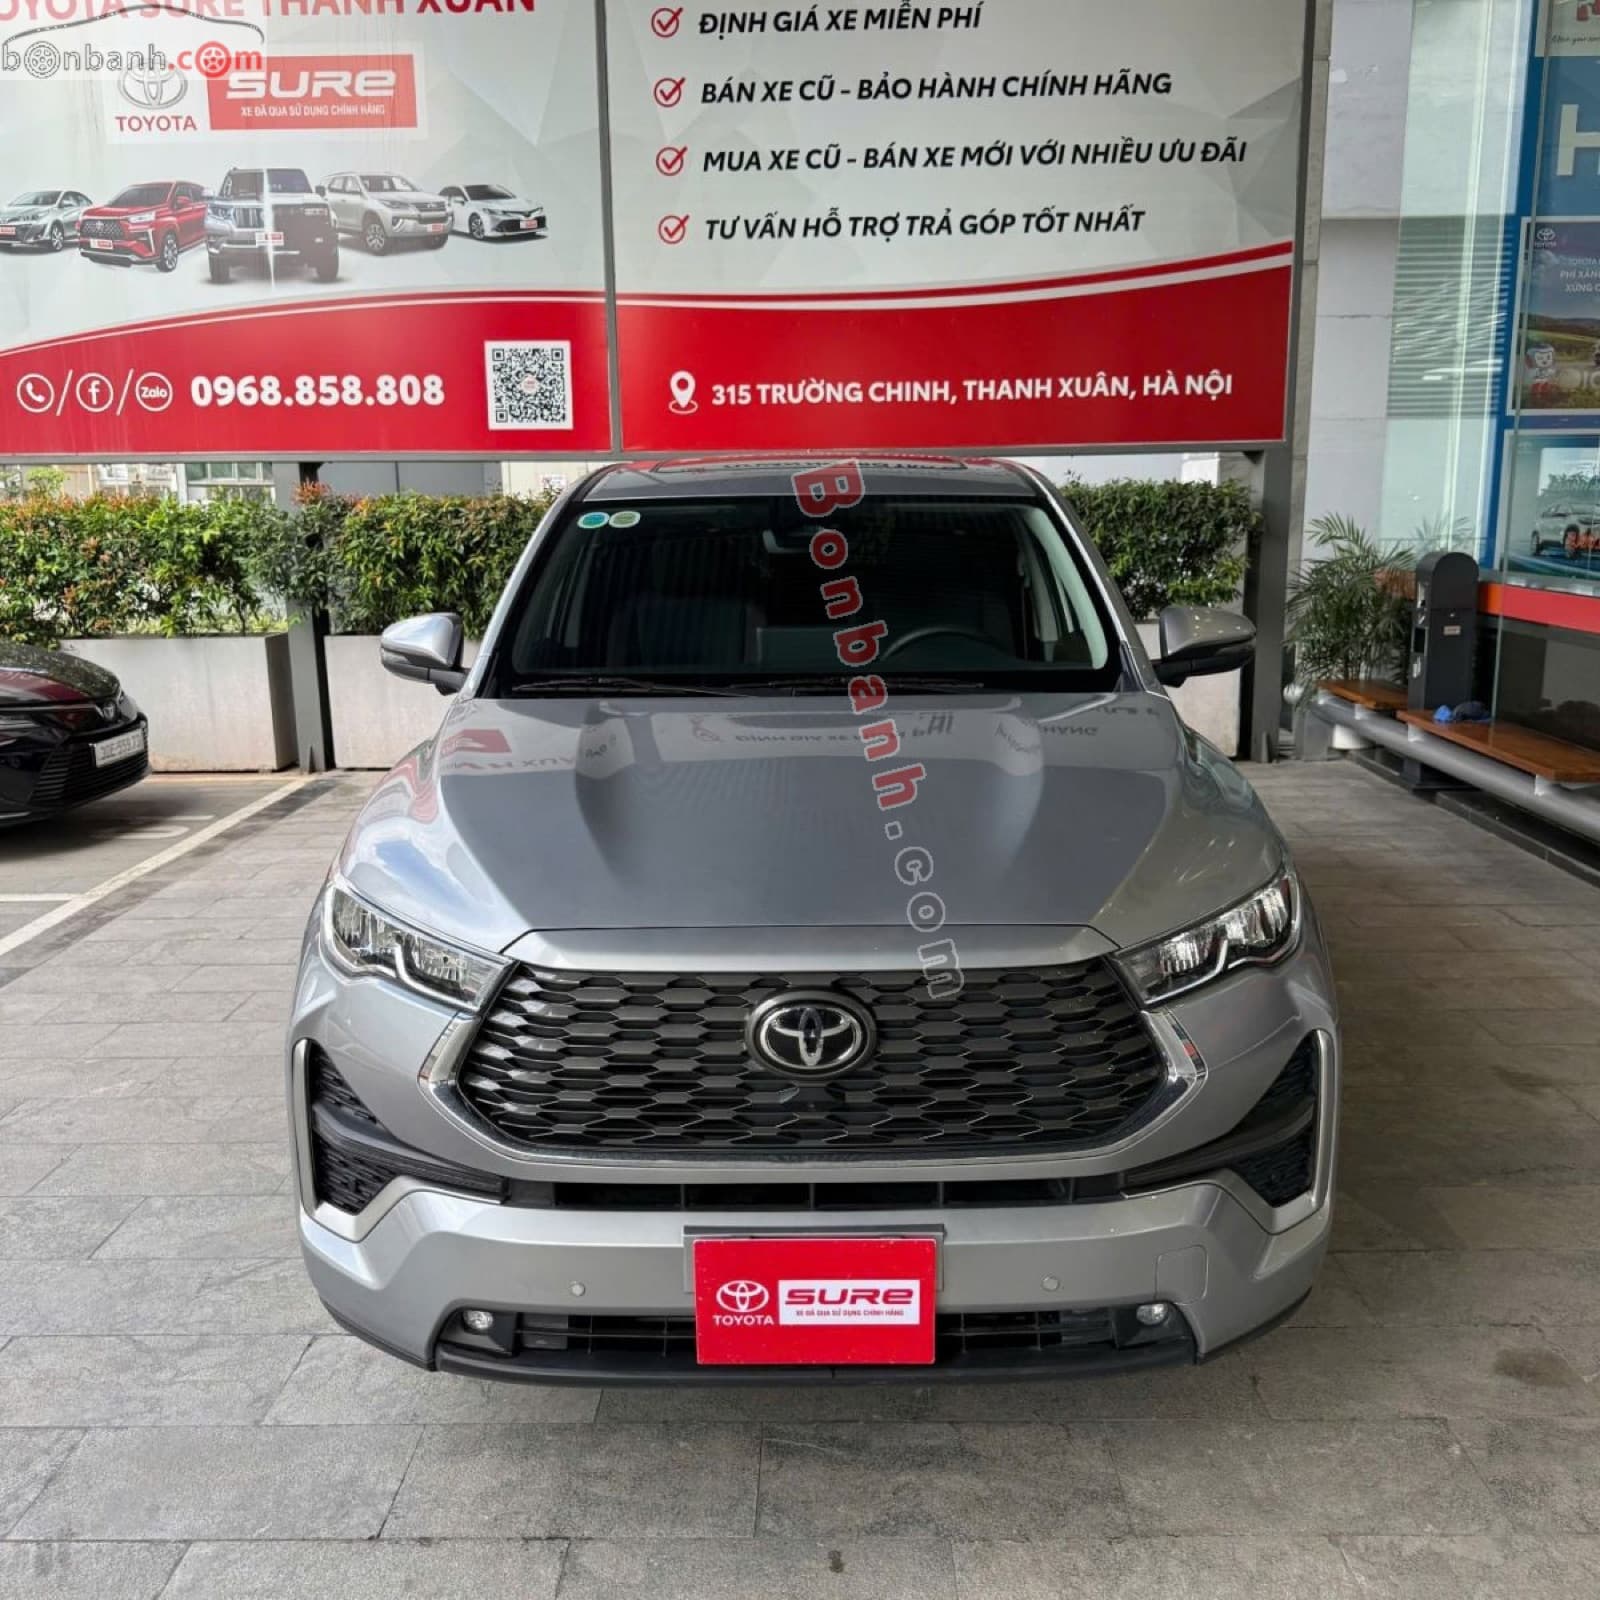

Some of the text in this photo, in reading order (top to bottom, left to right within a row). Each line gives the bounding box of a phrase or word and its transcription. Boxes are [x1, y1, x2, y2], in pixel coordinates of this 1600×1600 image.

[699, 0, 984, 40] ĐỊNH GIÁ XE MIỄN PHÍ
[702, 76, 755, 103] BÁN
[761, 81, 793, 101] XE
[800, 75, 835, 100] CŨ
[858, 72, 912, 99] BẢO
[918, 72, 996, 98] HÀNH
[1003, 70, 1088, 97] CHÍNH
[1094, 69, 1172, 95] HÃNG
[115, 116, 197, 131] TOYOTA
[704, 150, 761, 172] MUA
[768, 150, 800, 170] XE
[806, 144, 840, 169] CŨ
[864, 142, 917, 168] BÁN
[923, 147, 955, 167] XE
[961, 140, 1013, 166] MỚI
[1021, 139, 1065, 165] VỚI
[1072, 136, 1152, 164] NHIỀU
[1159, 139, 1196, 163] ƯU
[1200, 136, 1247, 162] ĐÃI
[706, 204, 1145, 243] TƯ VẤN HỖ TRỢ TRẢ GÓP TỐT NHẤT
[140, 386, 168, 398] Zalo
[191, 374, 445, 407] 0968.858.808
[712, 370, 1232, 405] 315 TRƯỜNG CHINH, THANH XUÂN, HÀ NỘI
[712, 1314, 774, 1326] TOYOTA
